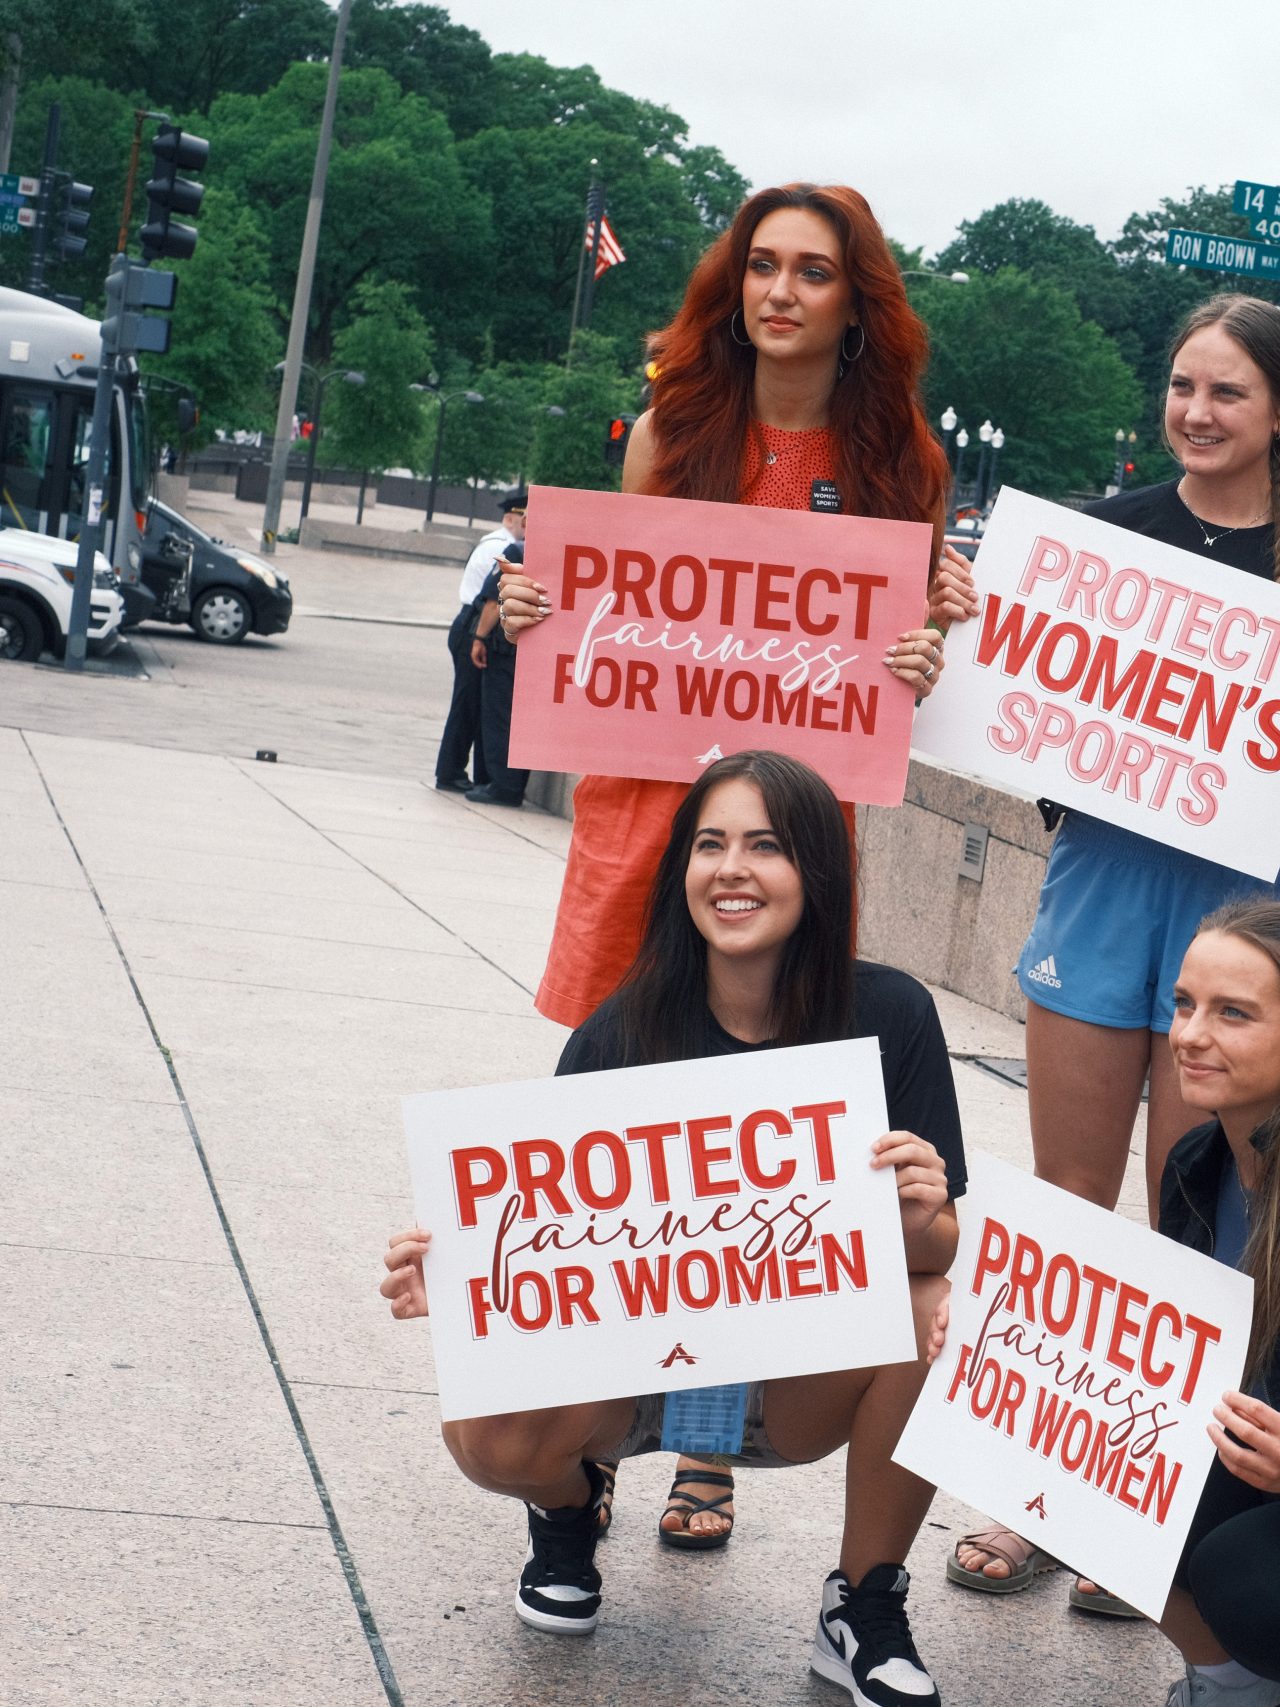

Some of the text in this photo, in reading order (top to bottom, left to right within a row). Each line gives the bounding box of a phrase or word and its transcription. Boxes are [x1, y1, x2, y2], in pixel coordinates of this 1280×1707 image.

[1171, 234, 1279, 270] RON BROWN WAY
[1244, 186, 1265, 213] 14
[560, 544, 889, 641] PROTECT
[574, 590, 860, 695] fairness
[553, 653, 879, 736] FOR WOMEN
[986, 690, 1228, 827] SPORTS
[1027, 968, 1062, 989] adidas
[448, 1100, 848, 1230] PROTECT
[467, 1229, 869, 1341] FOR WOMEN
[491, 1193, 832, 1314] fairness
[969, 1216, 1223, 1405] PROTECT
[967, 1281, 1180, 1460] fairness
[943, 1342, 1185, 1528] FOR WOMEN
